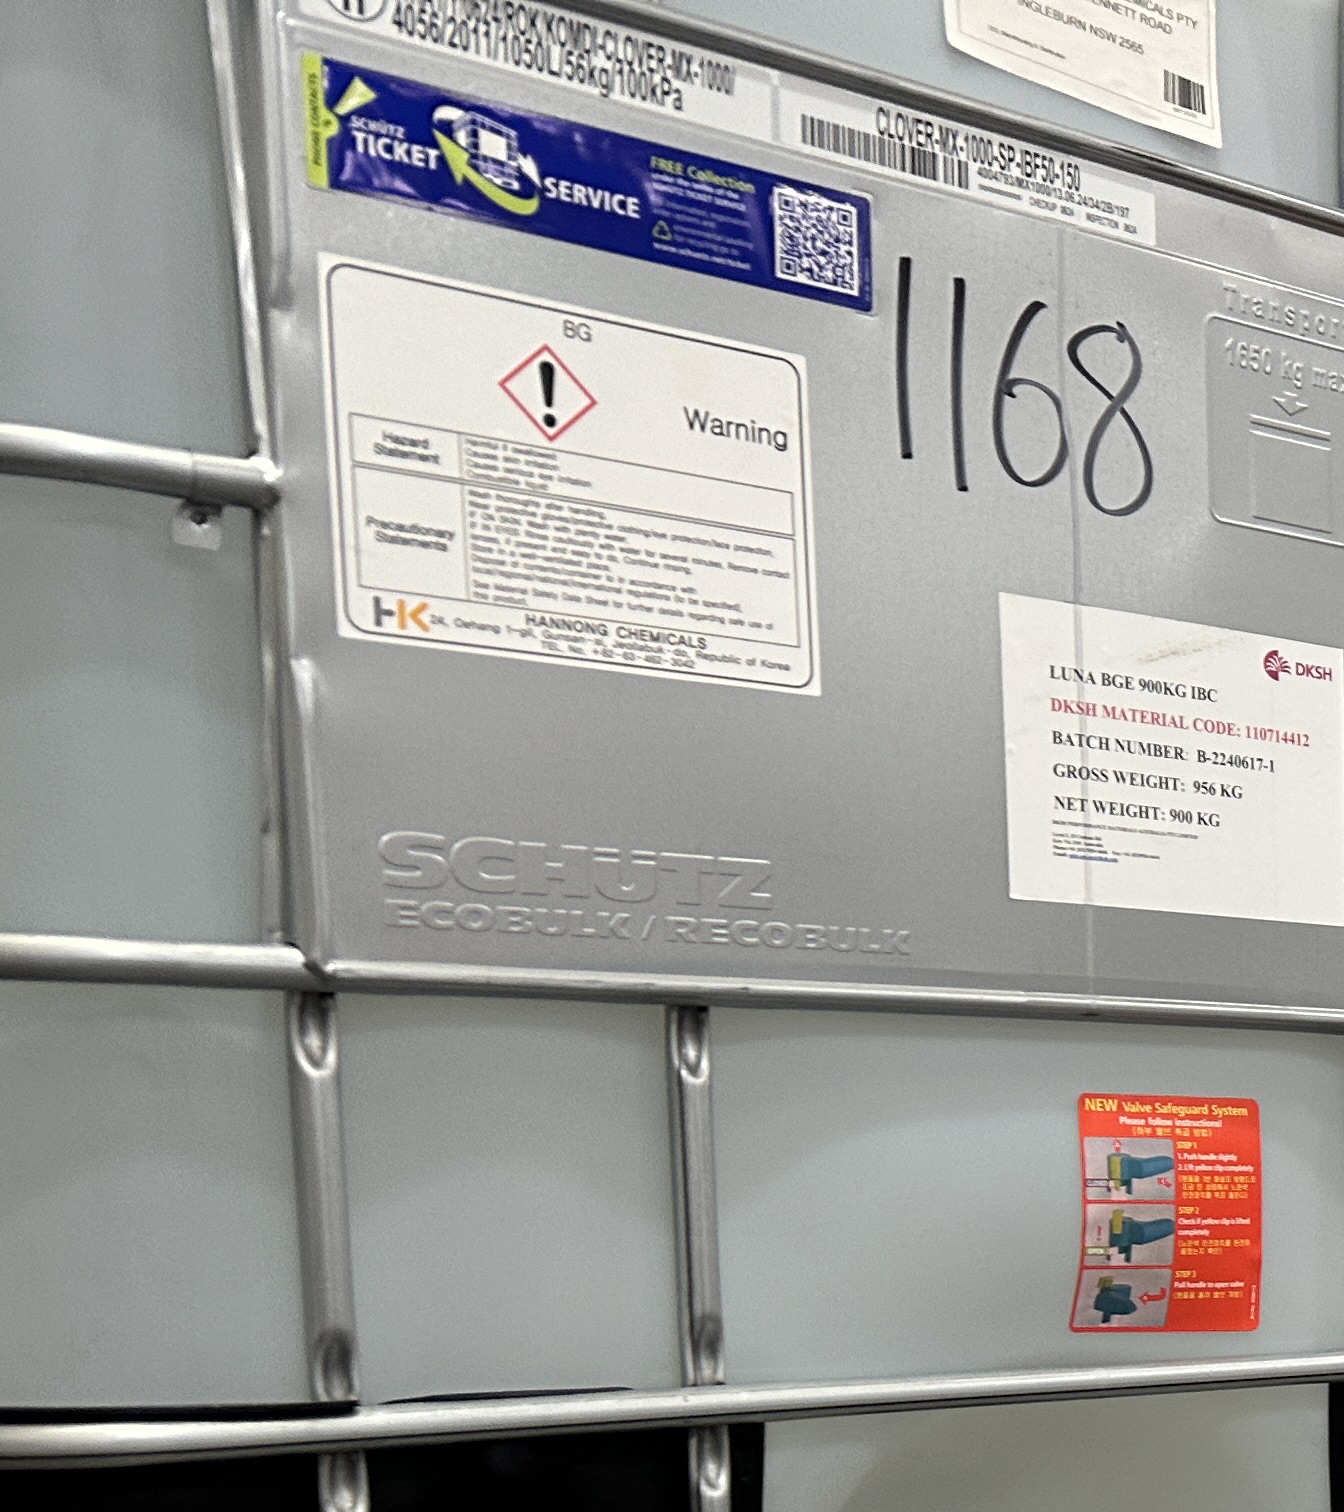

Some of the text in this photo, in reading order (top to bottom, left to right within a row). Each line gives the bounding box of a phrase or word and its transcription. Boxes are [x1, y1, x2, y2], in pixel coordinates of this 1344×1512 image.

[1089, 20, 1117, 45] NSW
[1140, 13, 1172, 34] ROAD
[1177, 12, 1198, 30] PTY
[875, 106, 1081, 192] CLOVER-MX-1000-SP-IBF50-150
[352, 130, 440, 170] TICKET
[543, 177, 642, 219] SERVICE
[650, 156, 685, 176] FREE
[686, 166, 756, 194] Collection
[563, 320, 593, 342] BG
[896, 256, 1154, 517] 1168
[683, 406, 788, 451] Warning
[524, 613, 708, 650] HANNONG CHEMICALS
[1049, 665, 1218, 703] LUNA BGE 900KG IBC
[1295, 662, 1333, 682] DKSH
[1050, 697, 1310, 747] DKSH MATERIAL CODE: 110714412
[1052, 730, 1275, 773] BATCH NUMBER: B-2240617-1
[1053, 763, 1244, 800] GROSS WEIGHT: 956 KG
[1053, 796, 1221, 828] NET WEIGHT: 900 KG
[378, 831, 772, 910] SCHÜTZ
[1084, 1098, 1248, 1117] NEW Valve Safeguard System
[1119, 1116, 1146, 1126] Please
